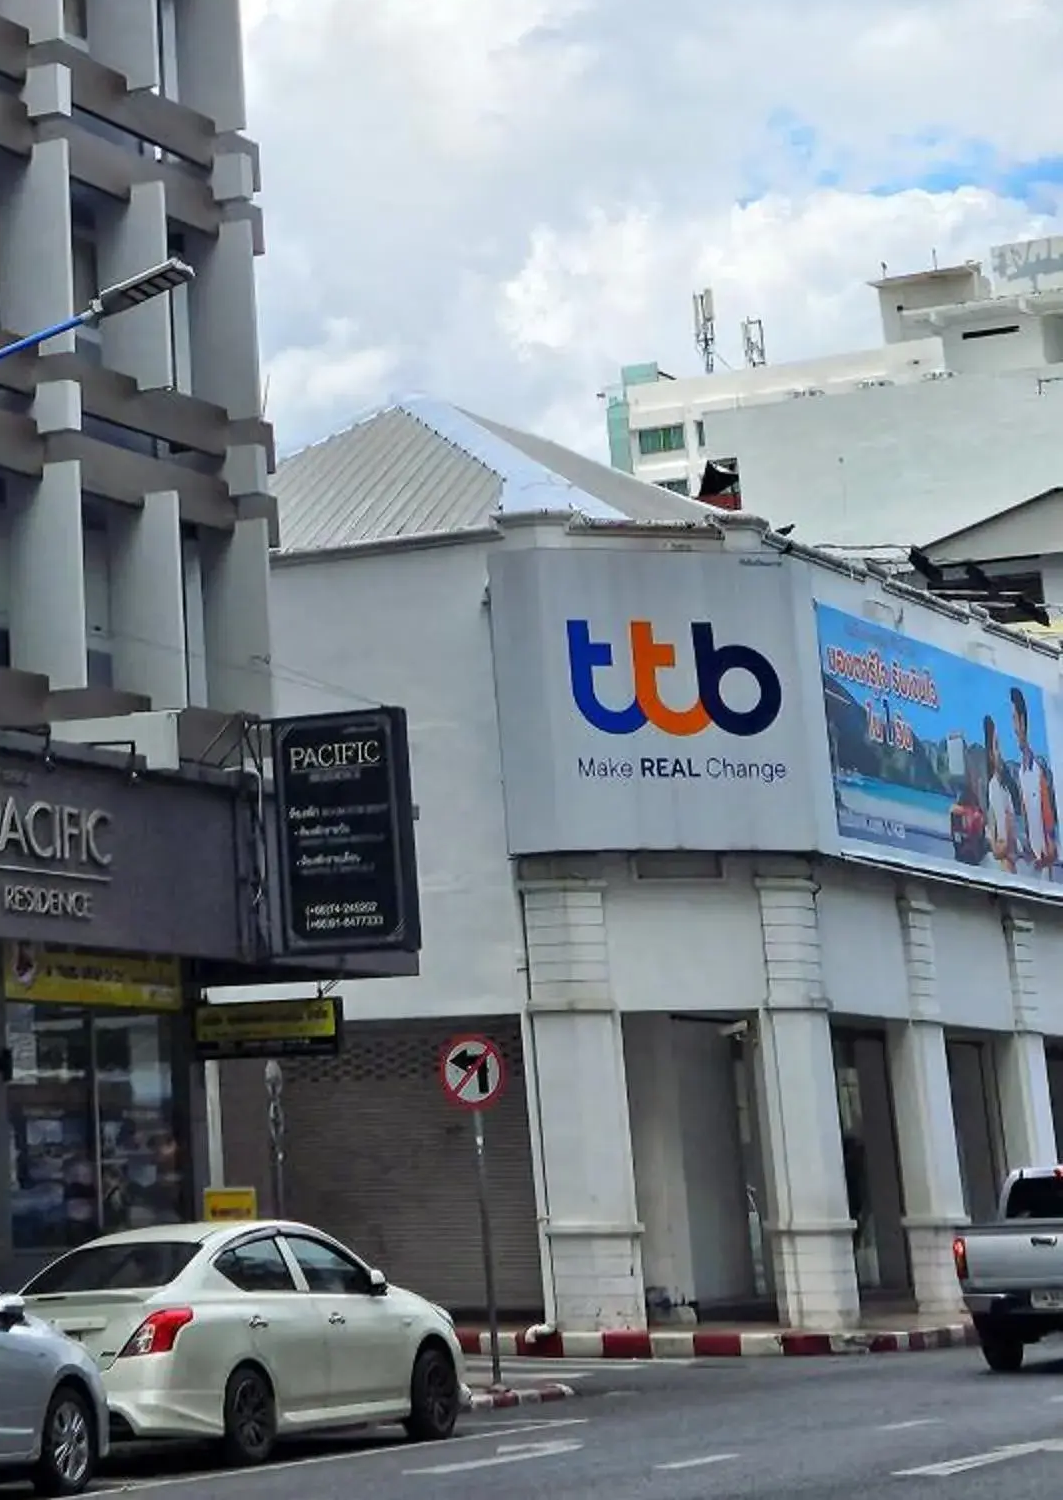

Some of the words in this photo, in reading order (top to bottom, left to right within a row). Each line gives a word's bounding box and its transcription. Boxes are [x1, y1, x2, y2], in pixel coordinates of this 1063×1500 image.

[566, 619, 782, 736] ttb
[290, 740, 380, 770] PACIFIC
[578, 758, 633, 777] Make
[641, 758, 701, 777] REAL
[706, 757, 786, 783] Change
[3, 884, 95, 918] RESIDENCE
